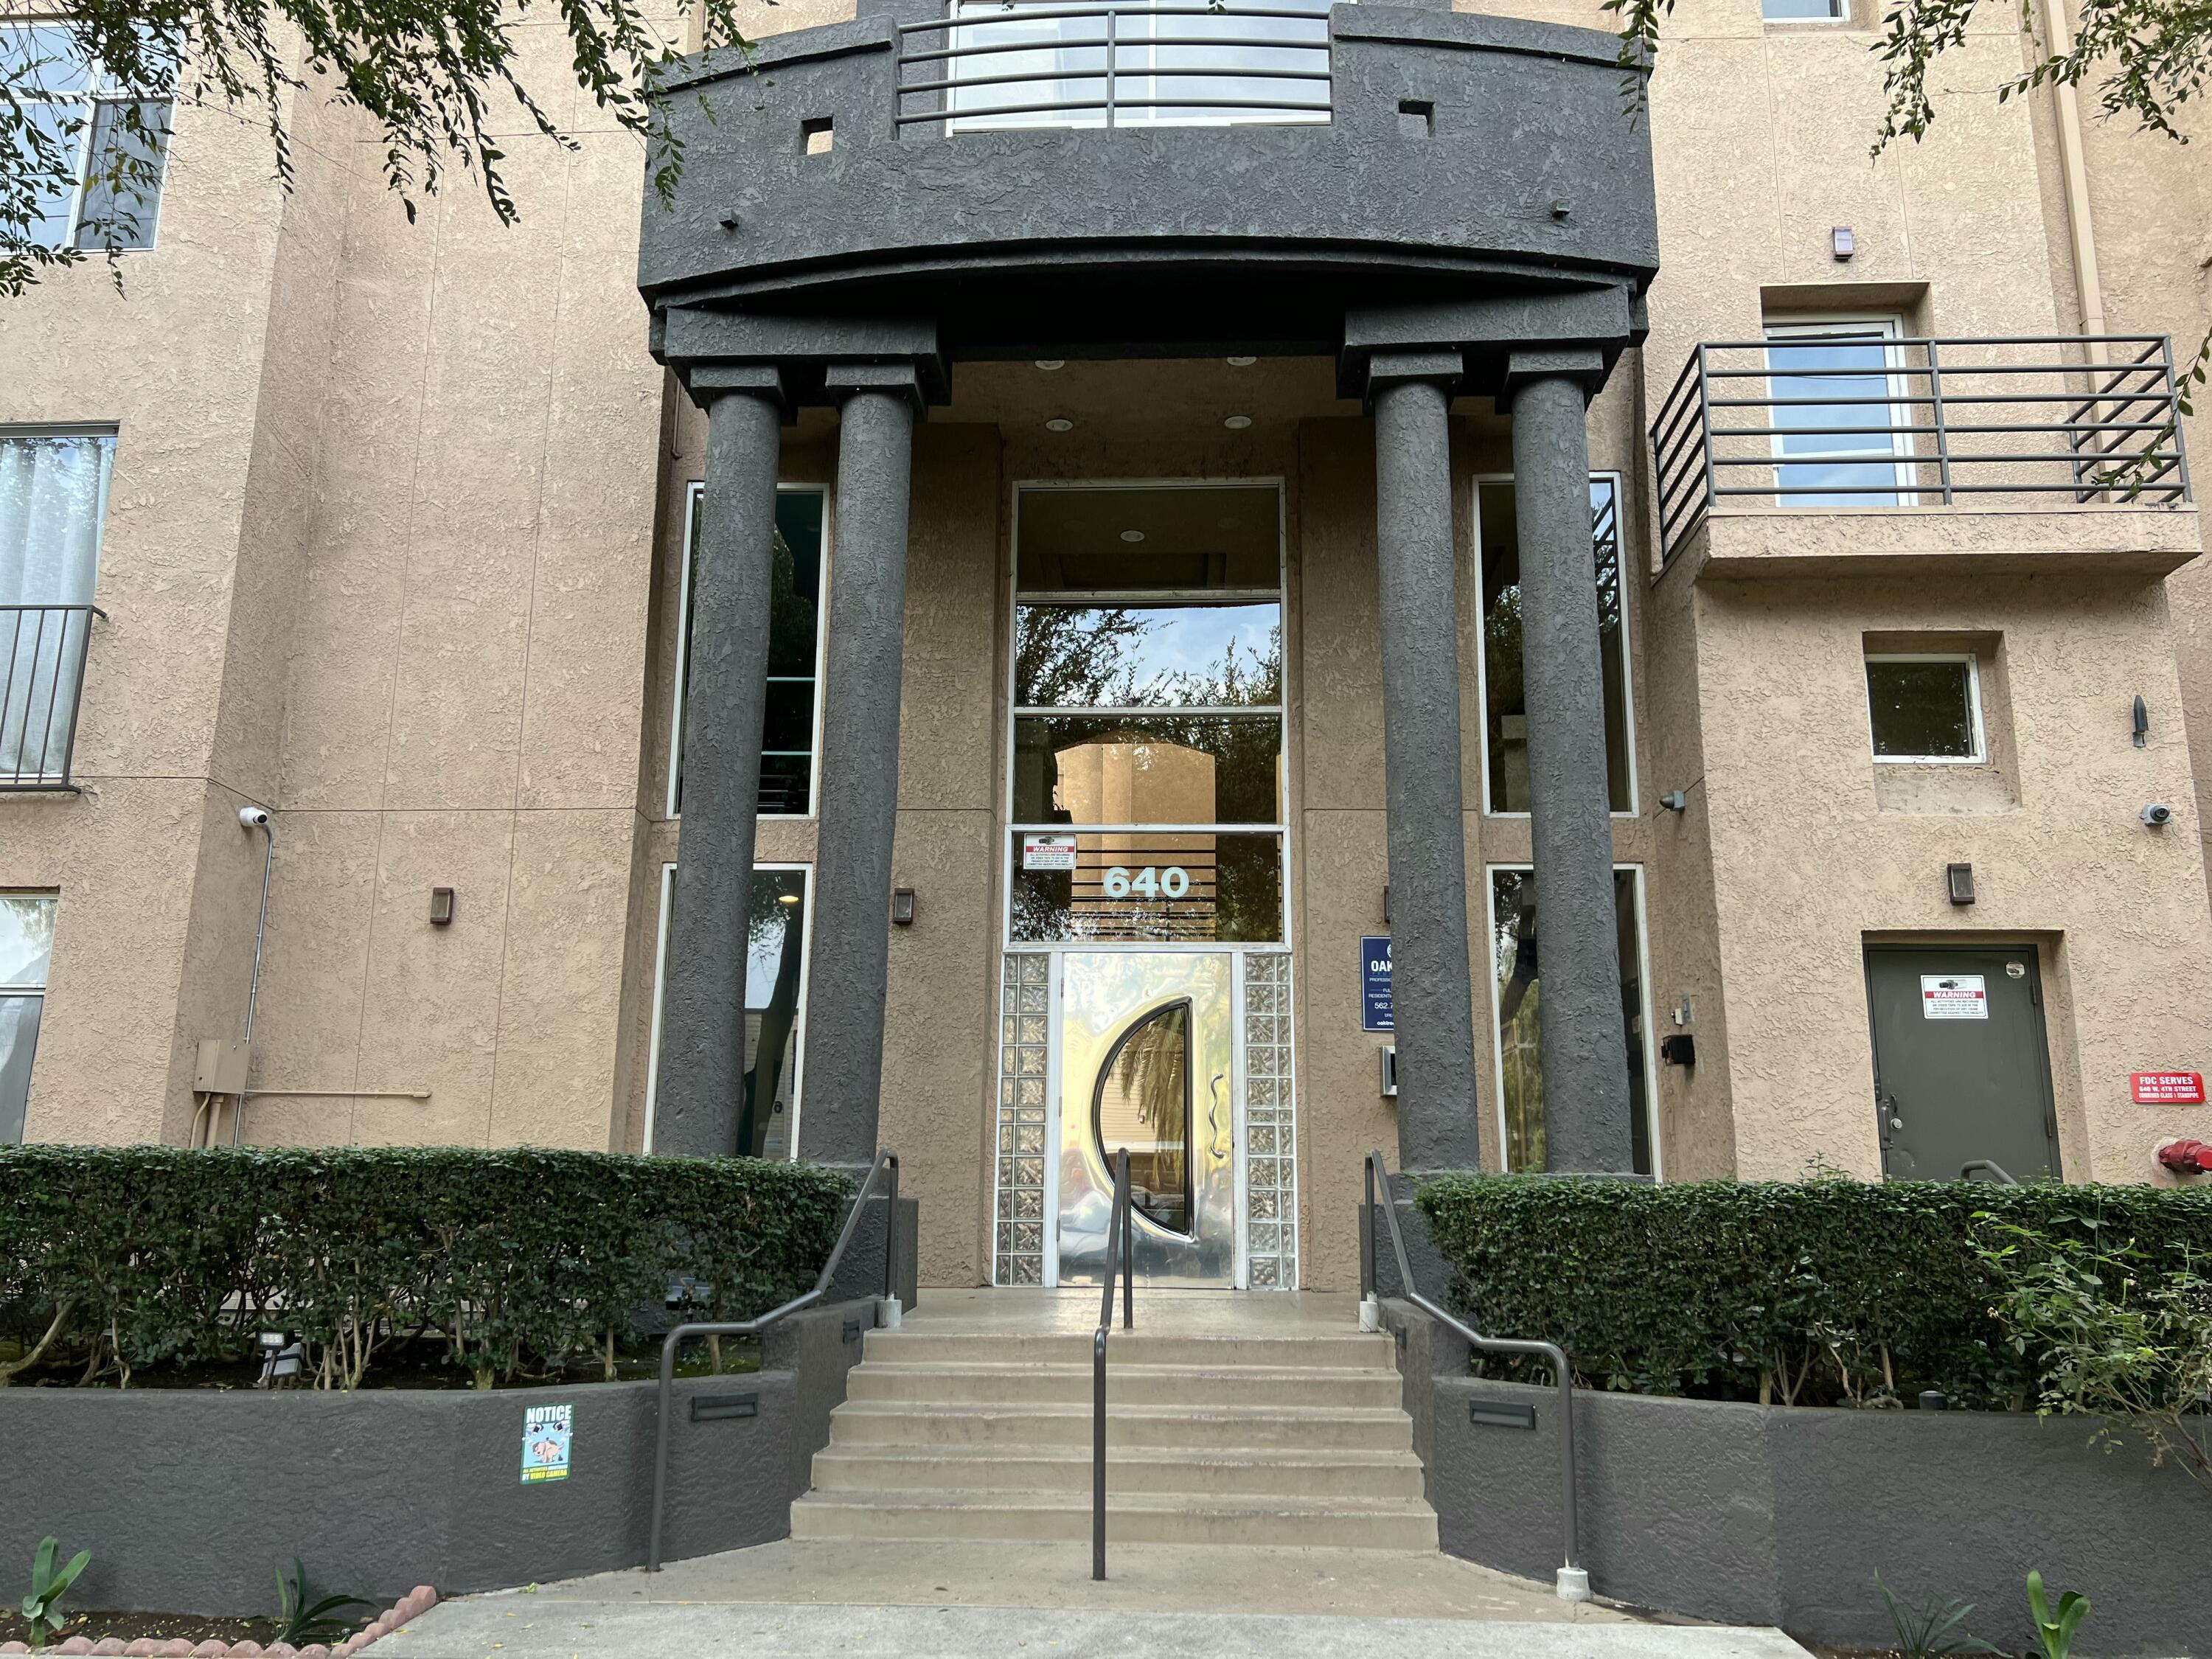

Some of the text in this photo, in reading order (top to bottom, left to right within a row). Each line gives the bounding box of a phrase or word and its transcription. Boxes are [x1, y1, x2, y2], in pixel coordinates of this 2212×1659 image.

[1103, 866, 1189, 898] 640
[2140, 1076, 2194, 1085] FDC SERVES
[526, 1405, 572, 1424] NOTICE
